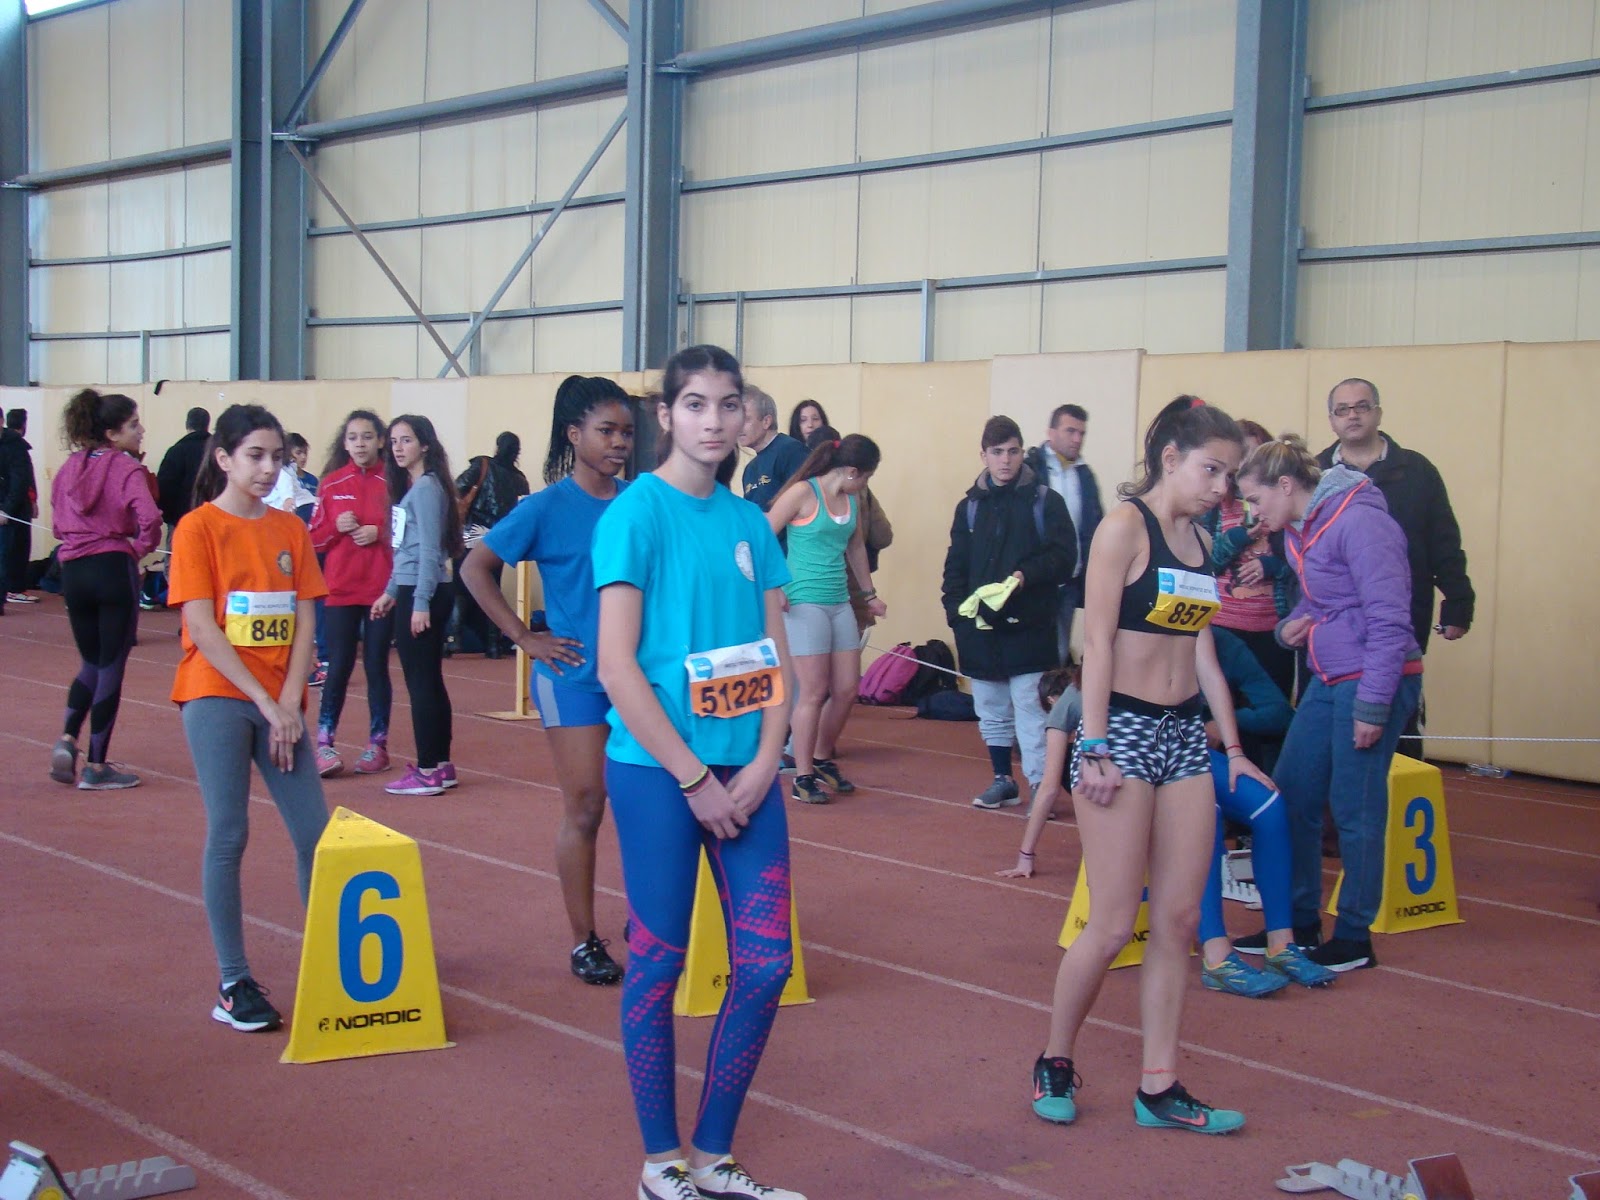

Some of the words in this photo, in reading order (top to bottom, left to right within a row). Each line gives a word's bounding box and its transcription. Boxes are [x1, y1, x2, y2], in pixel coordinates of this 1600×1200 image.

[1167, 601, 1212, 626] 857
[252, 618, 289, 642] 848
[701, 673, 773, 714] 51229
[1404, 796, 1437, 896] 3
[1403, 901, 1446, 918] NORDIC
[338, 870, 404, 1004] 6
[335, 1008, 421, 1031] NORDIC
